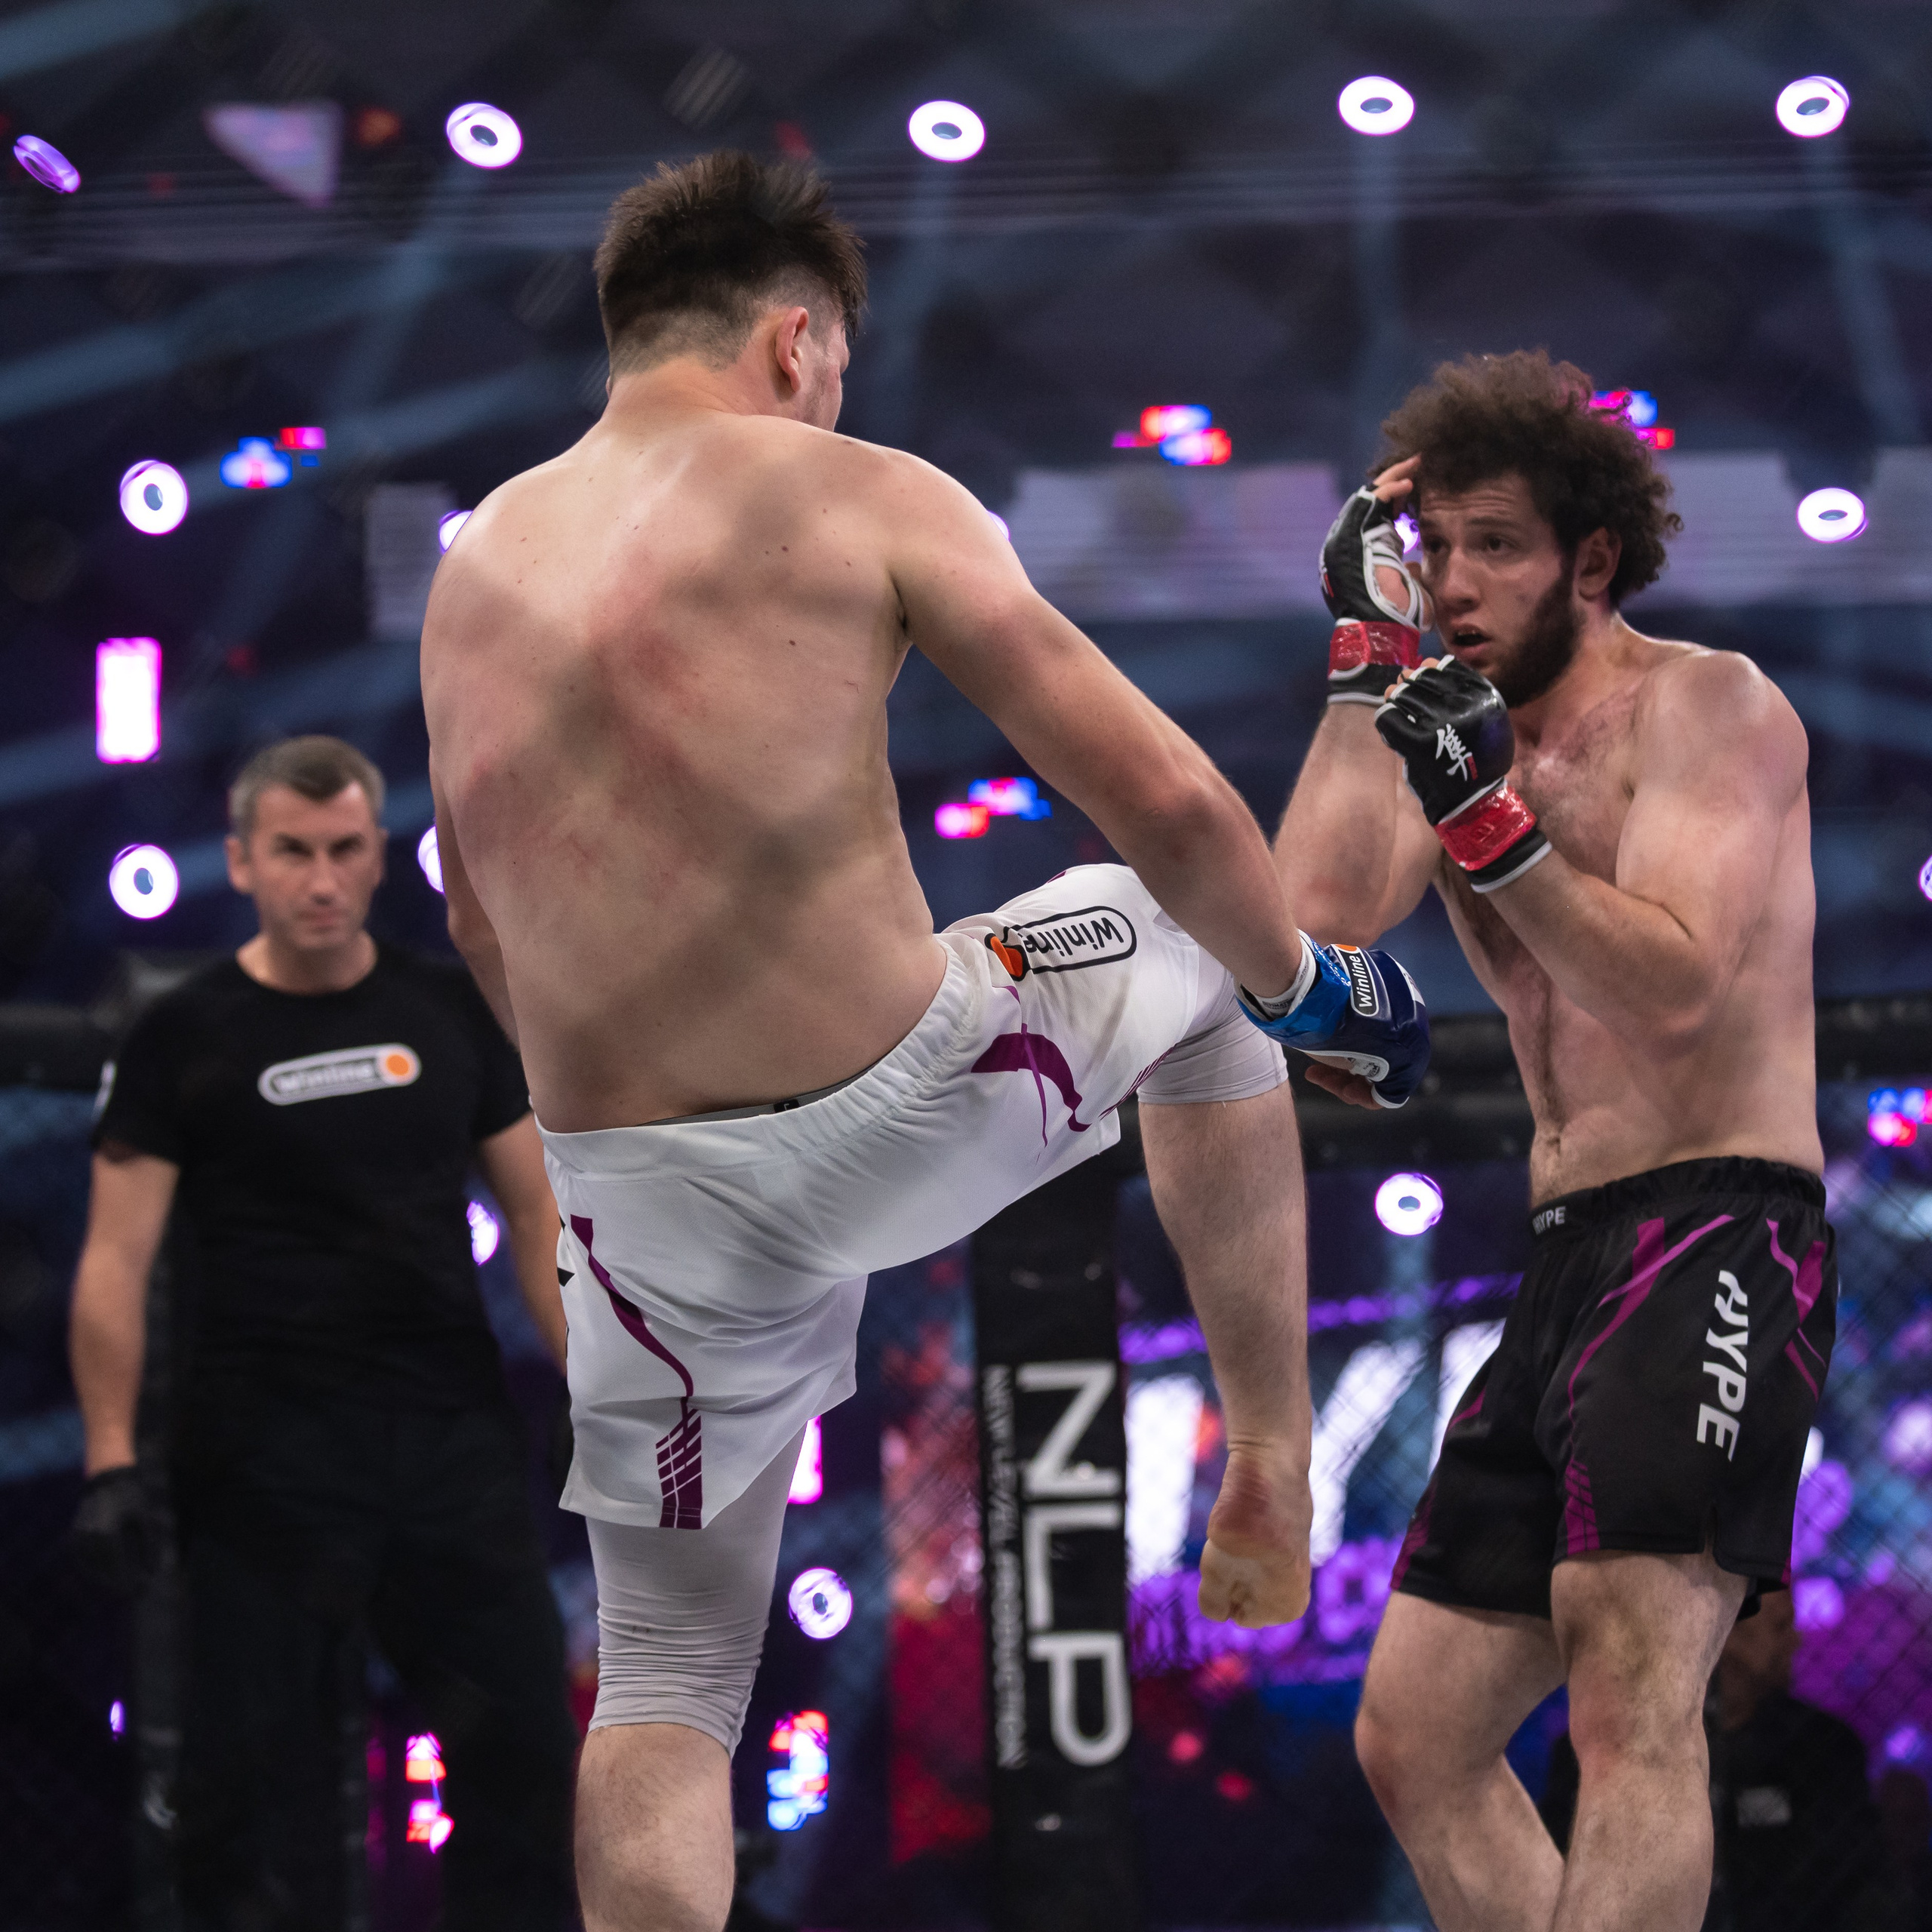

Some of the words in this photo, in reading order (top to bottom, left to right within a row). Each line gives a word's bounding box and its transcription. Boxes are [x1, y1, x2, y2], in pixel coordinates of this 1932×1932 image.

[1435, 723, 1472, 781] 隼
[1697, 1269, 1749, 1462] HYPE
[1016, 1361, 1132, 1767] NLP
